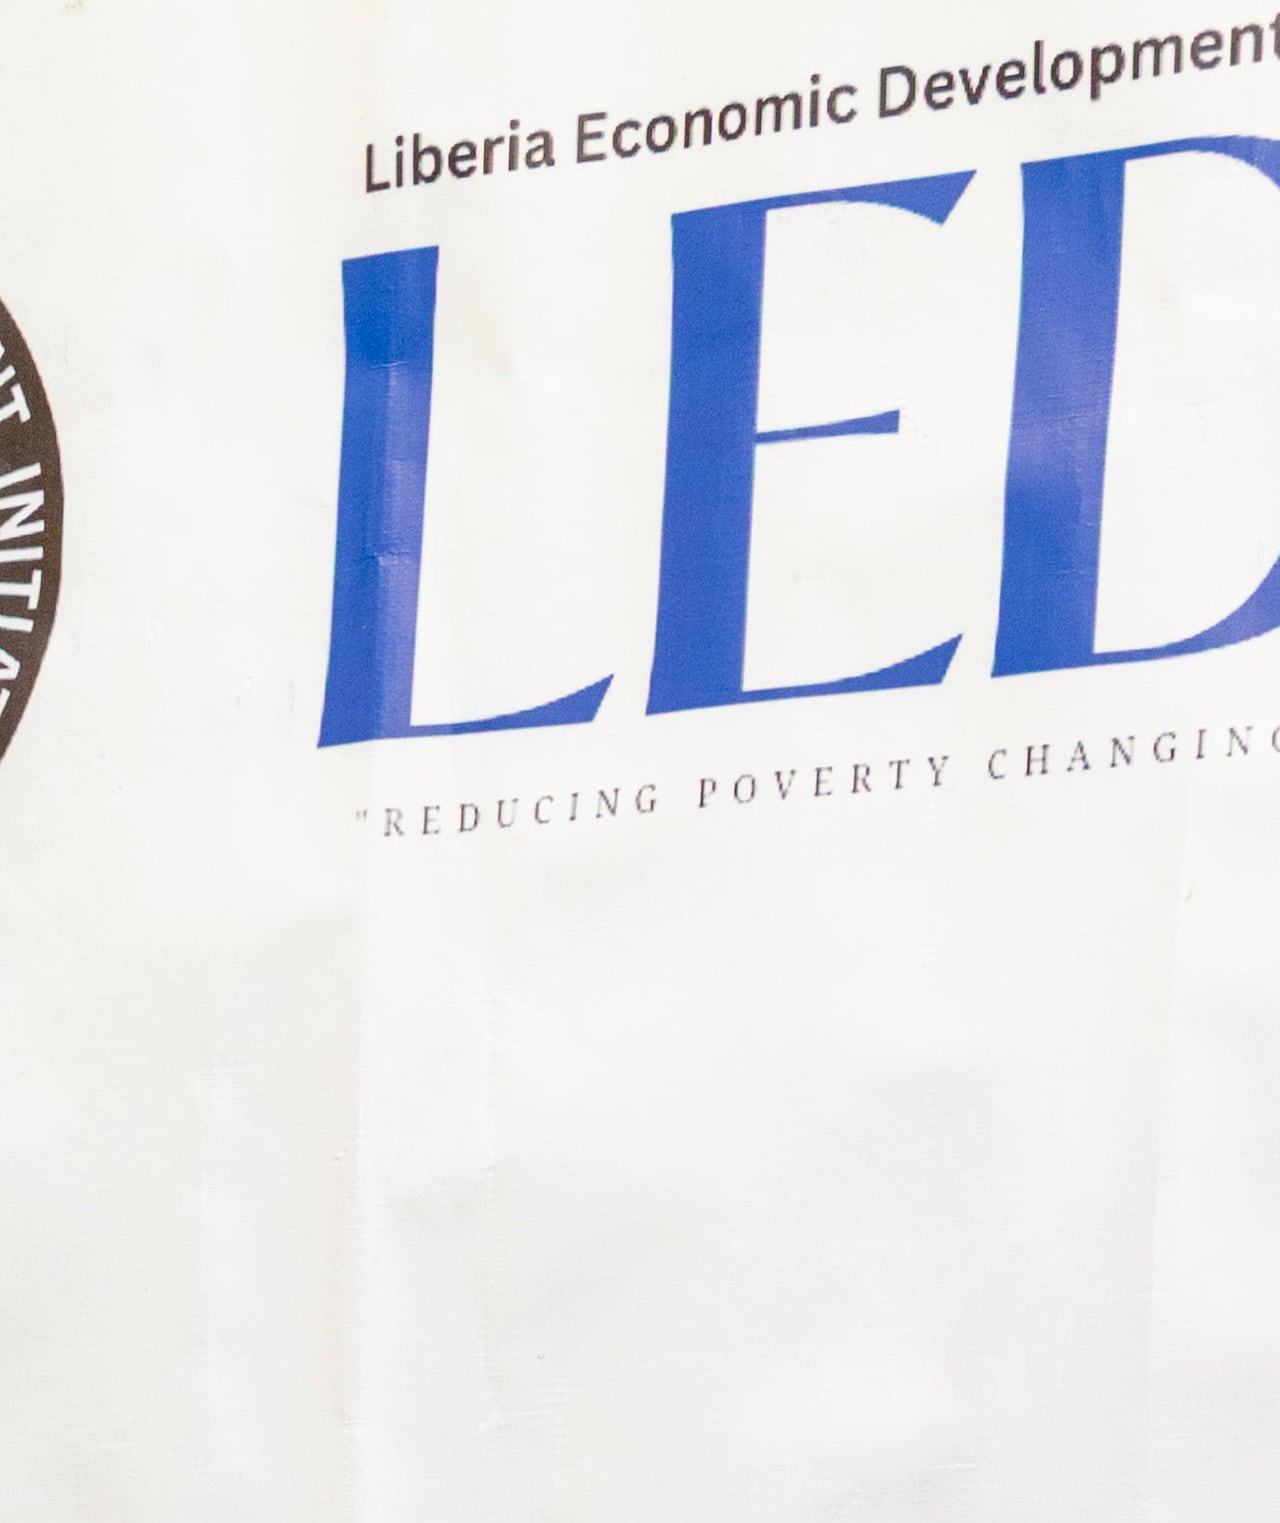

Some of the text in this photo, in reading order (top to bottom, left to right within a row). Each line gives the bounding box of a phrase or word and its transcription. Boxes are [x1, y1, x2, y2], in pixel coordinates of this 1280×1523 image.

[364, 118, 556, 193] Liberia
[575, 72, 859, 162] Economic
[316, 134, 1280, 749] LED
[354, 783, 661, 839] "REDUCING
[698, 752, 951, 811] POVERTY
